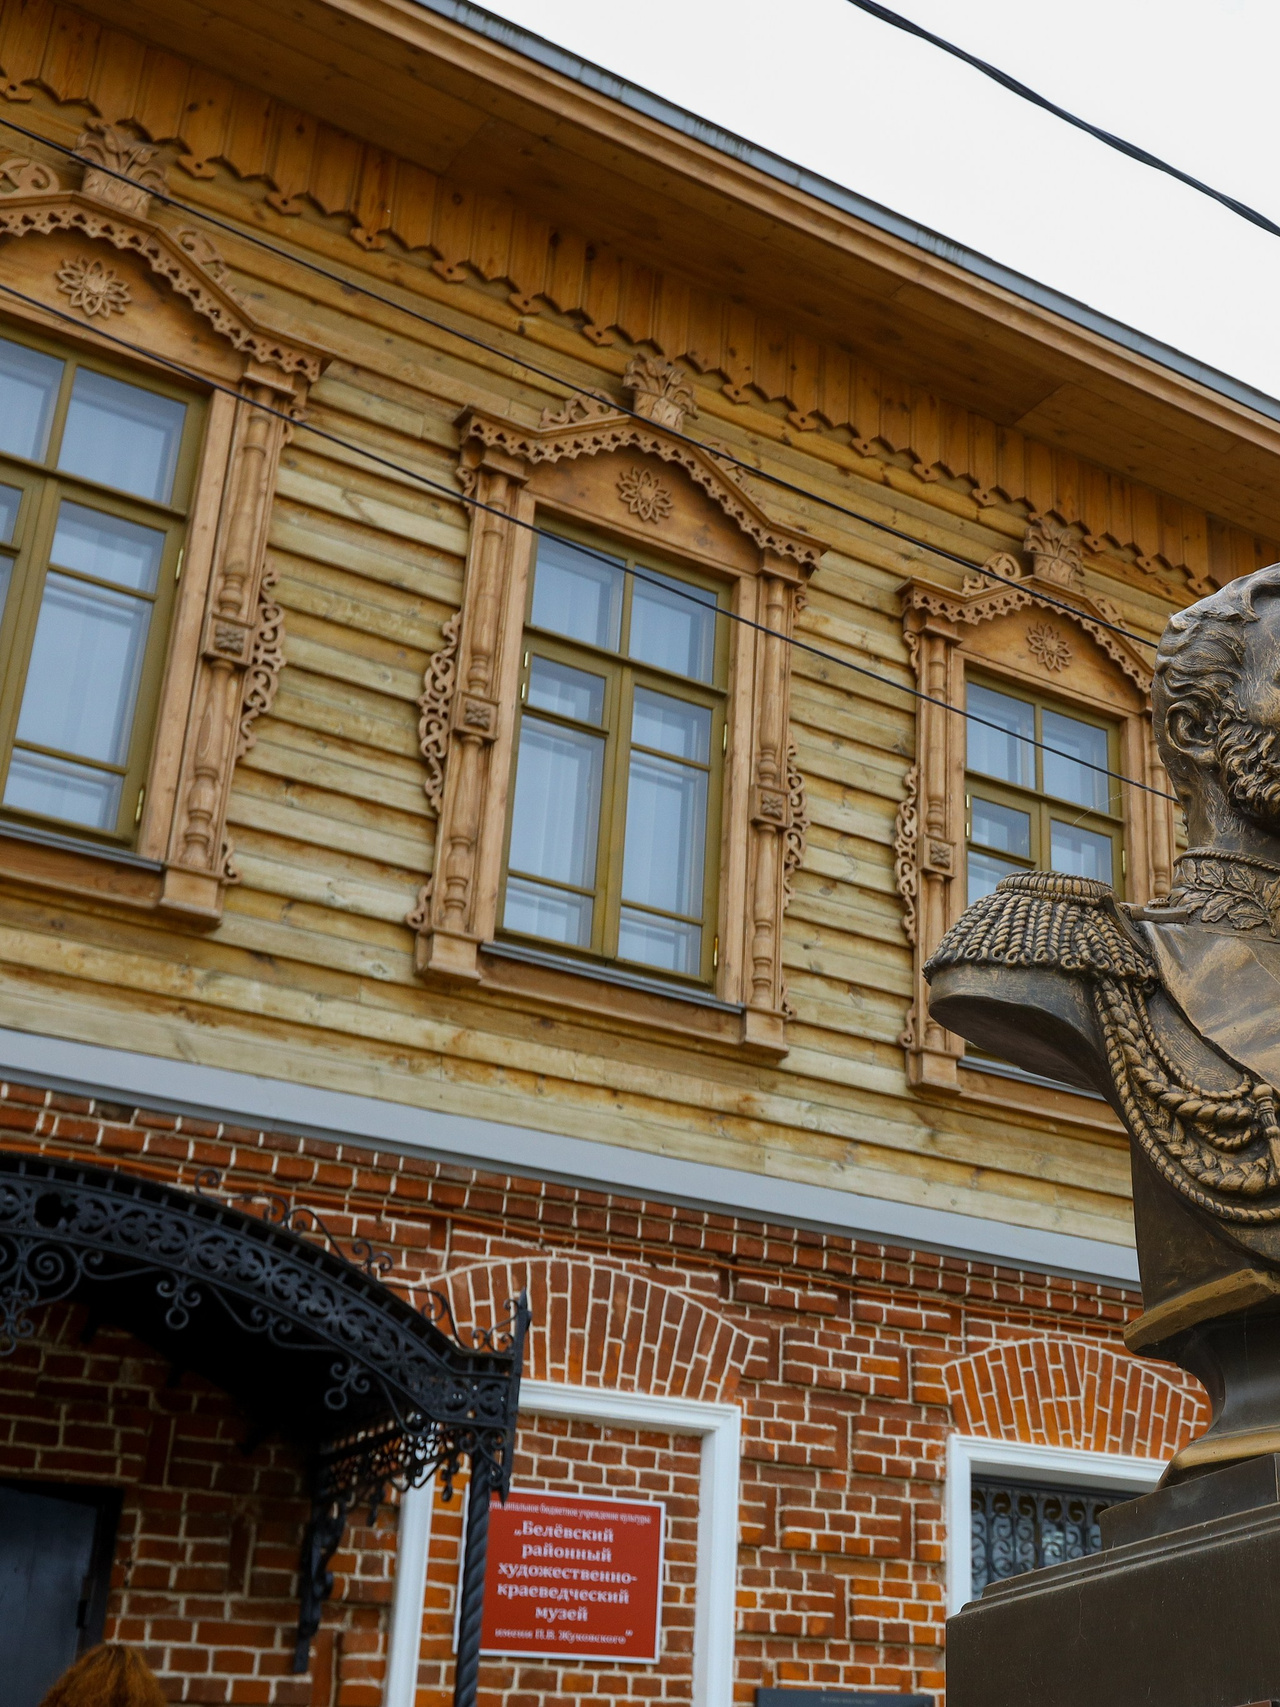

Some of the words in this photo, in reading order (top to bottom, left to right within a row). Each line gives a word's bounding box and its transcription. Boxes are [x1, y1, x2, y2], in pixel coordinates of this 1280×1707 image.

[521, 1543, 612, 1563] районный
[498, 1562, 638, 1585] художественно-
[497, 1583, 630, 1605] краеведческий
[535, 1606, 588, 1623] музей
[495, 1628, 533, 1639] имени
